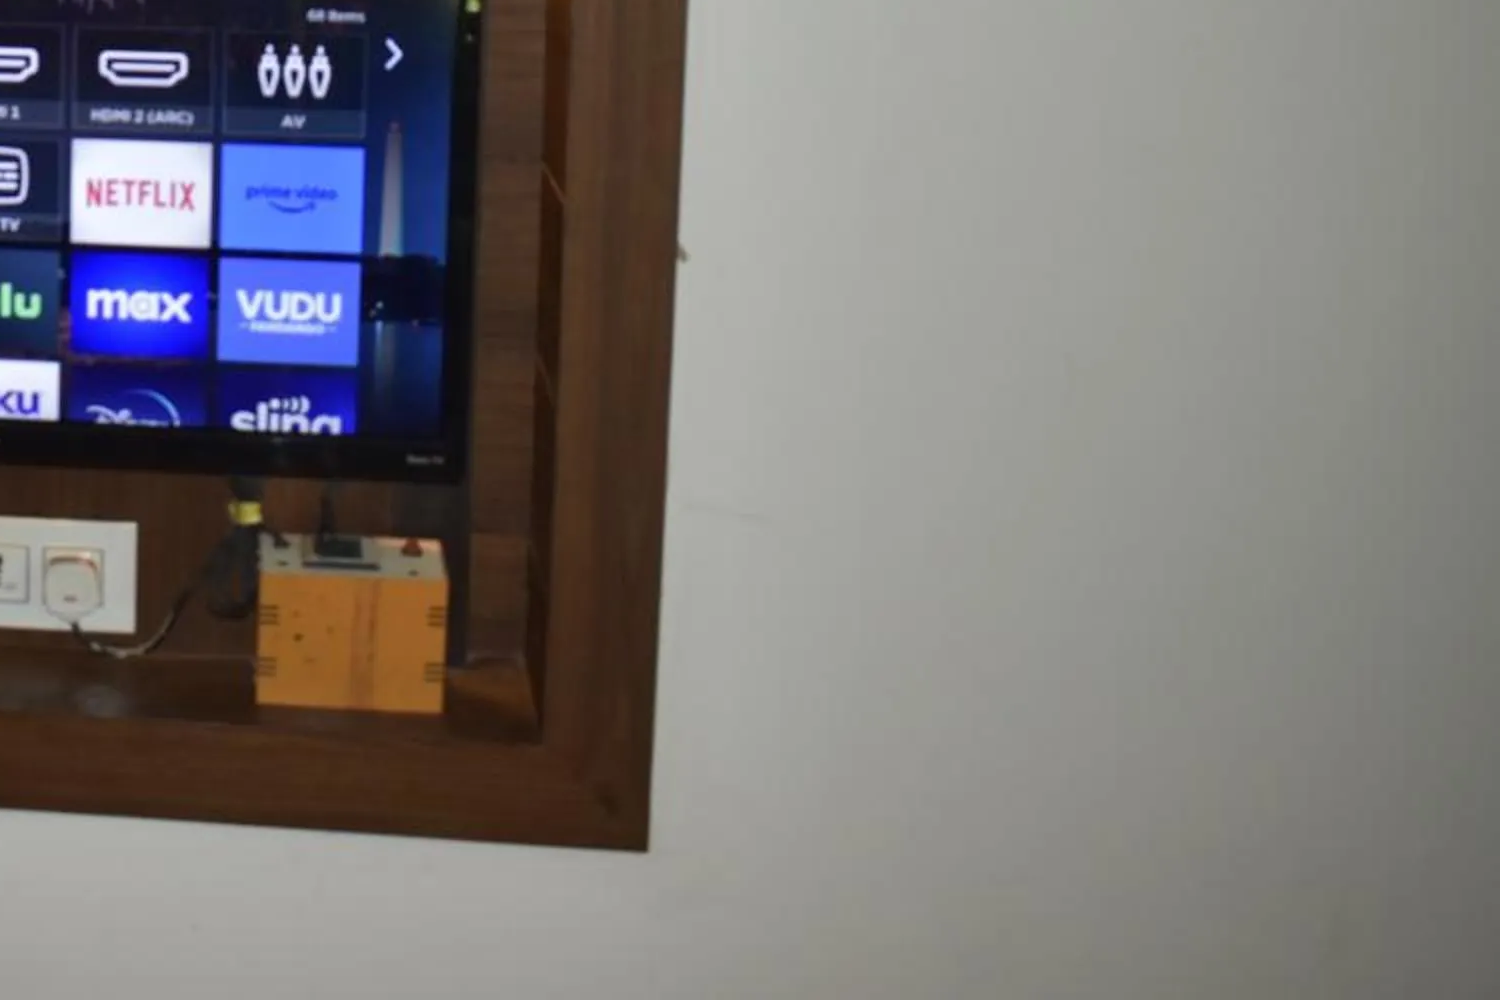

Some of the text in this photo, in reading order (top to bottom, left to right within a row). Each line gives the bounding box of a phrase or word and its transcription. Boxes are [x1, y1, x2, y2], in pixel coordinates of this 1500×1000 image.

[10, 105, 20, 120] 1
[90, 107, 195, 127] HDMI 2 (ARC)
[281, 114, 306, 130] AV
[86, 179, 195, 211] NETFLIX
[246, 186, 339, 202] prime video
[0, 218, 21, 232] TV
[86, 288, 192, 324] max
[235, 288, 342, 324] VUDU
